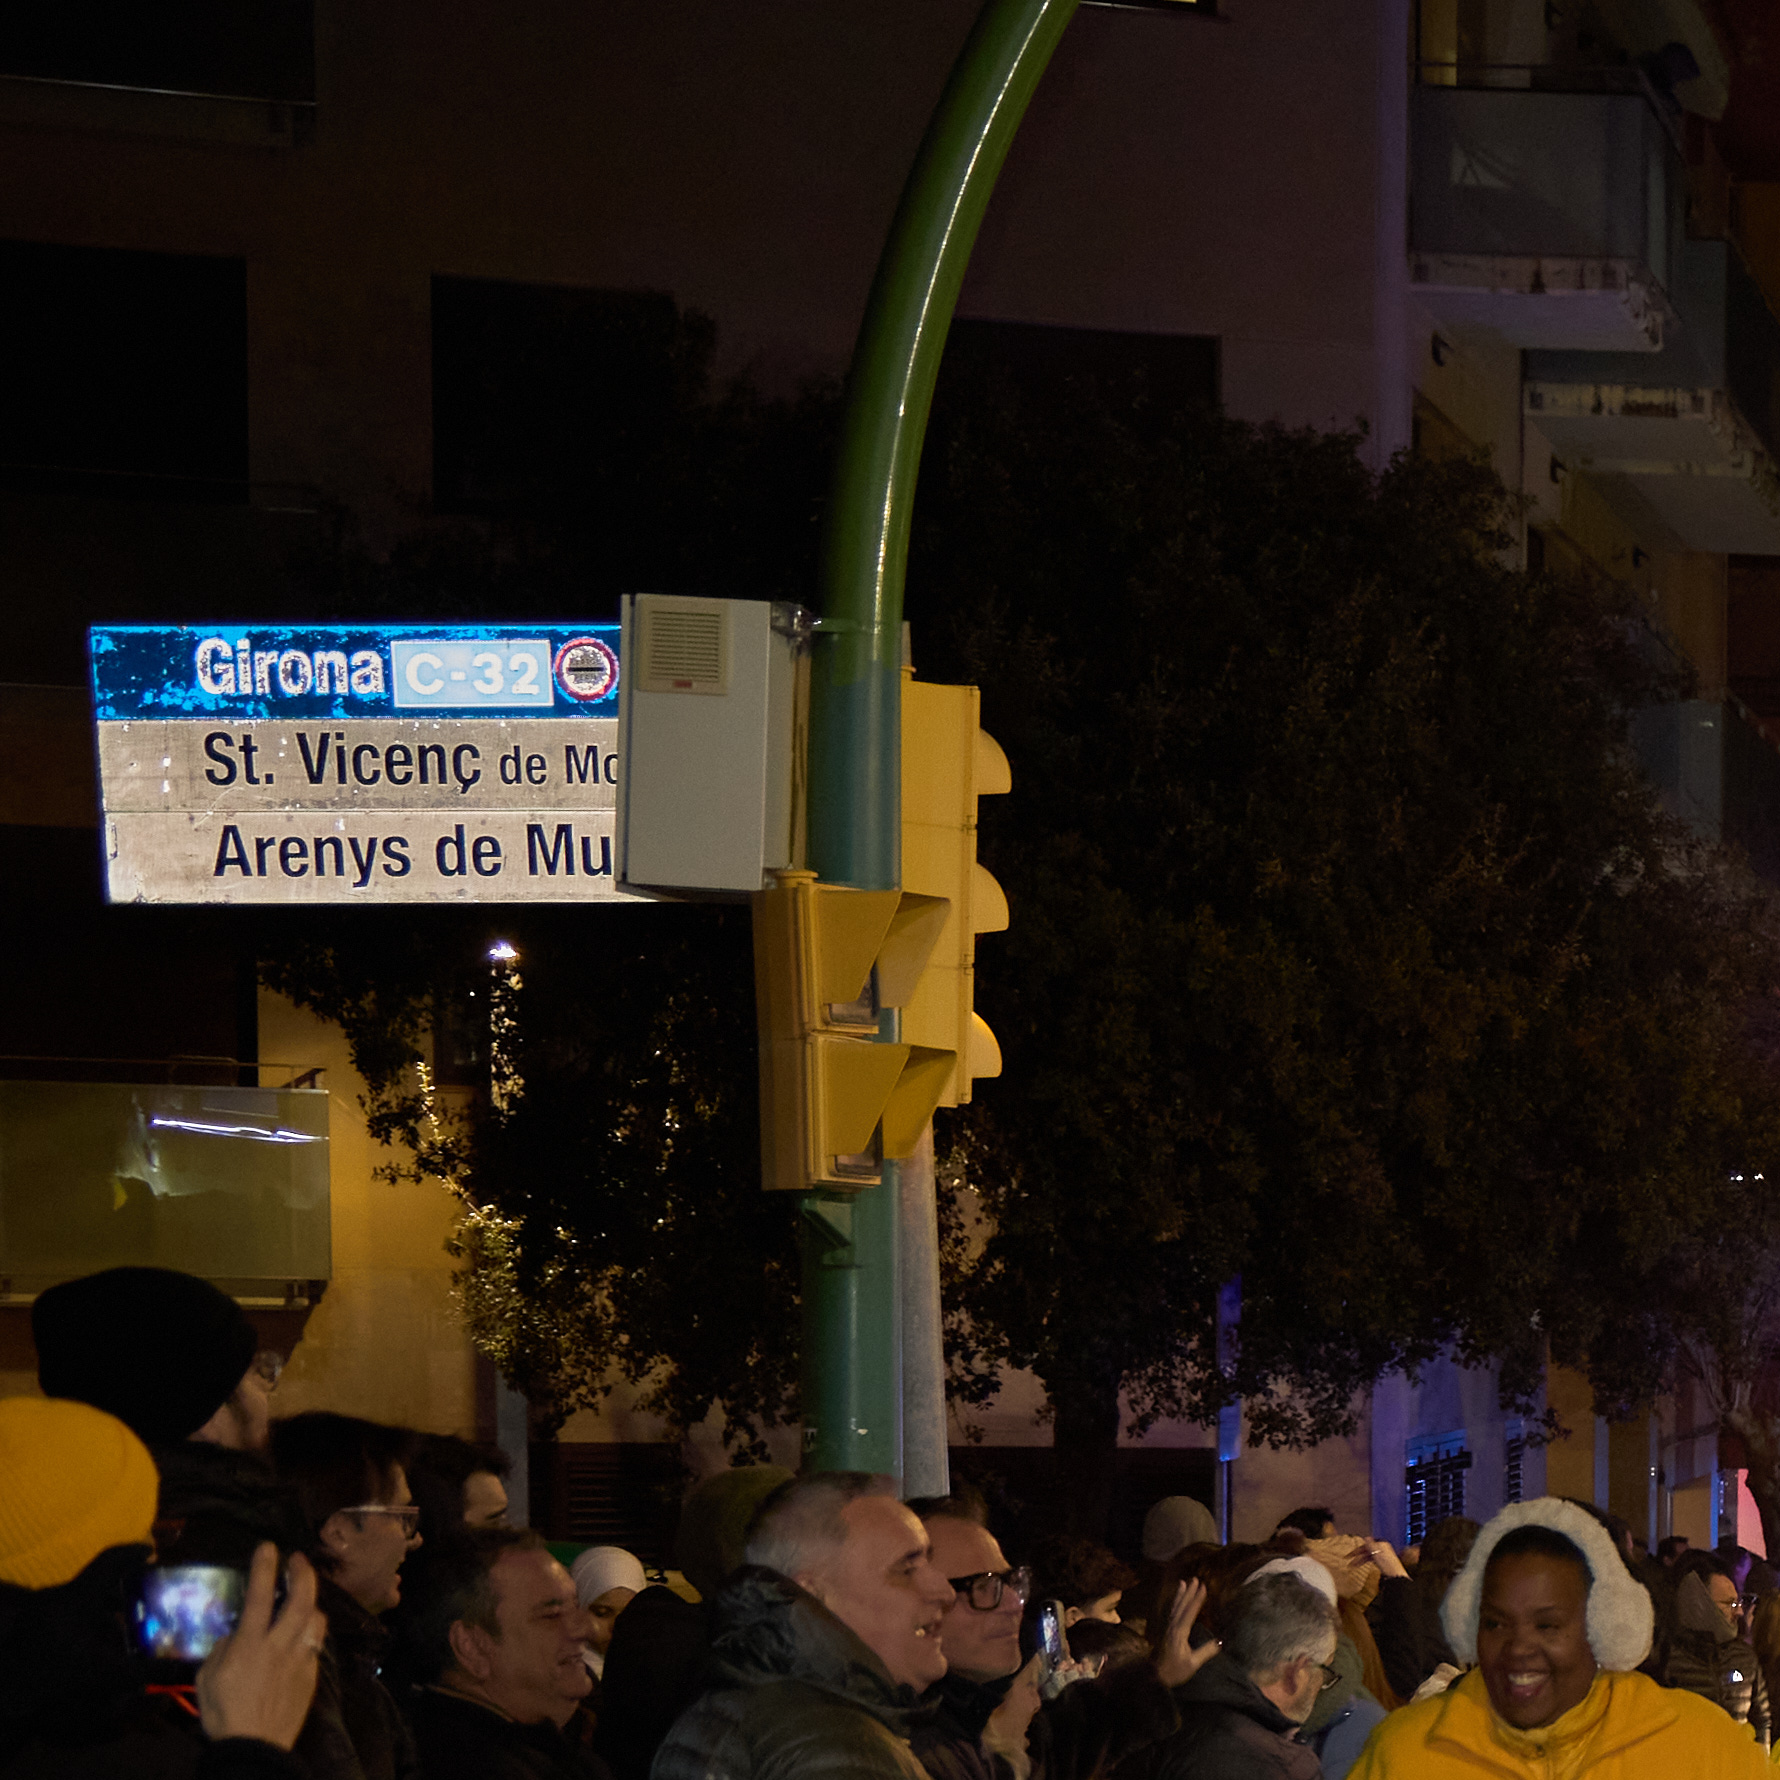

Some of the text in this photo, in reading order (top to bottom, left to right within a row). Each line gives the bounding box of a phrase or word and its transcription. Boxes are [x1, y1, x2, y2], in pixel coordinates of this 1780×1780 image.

[197, 638, 385, 694] Girona
[406, 653, 540, 695] C-32
[204, 731, 274, 785] St.
[296, 732, 481, 794] Vicenç
[500, 745, 547, 785] de
[213, 823, 612, 888] Arenys de Mu
